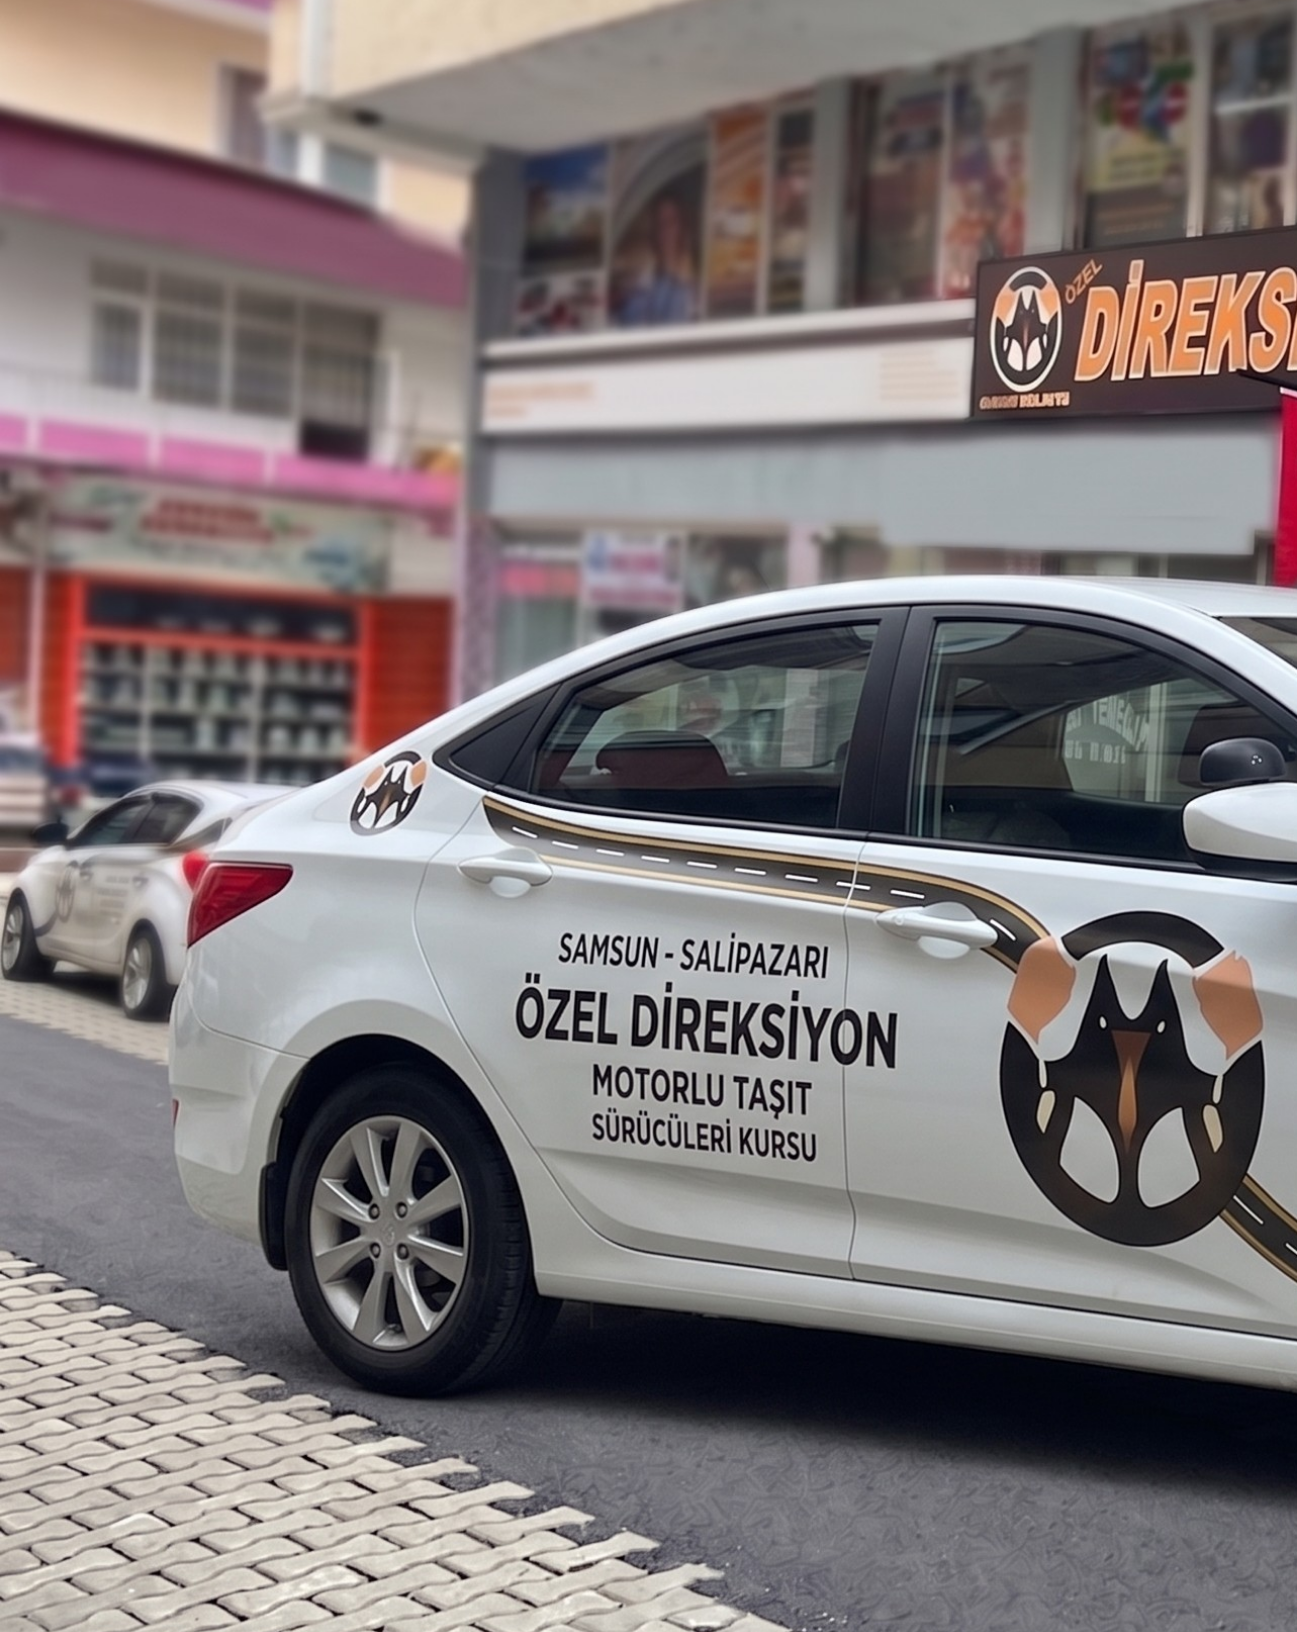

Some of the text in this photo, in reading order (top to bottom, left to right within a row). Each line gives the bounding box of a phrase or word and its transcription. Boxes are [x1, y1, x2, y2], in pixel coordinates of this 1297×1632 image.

[1065, 259, 1103, 304] ÖZEL
[558, 933, 659, 968] SAMSUN
[680, 932, 829, 979] SALİPAZARI
[516, 972, 898, 1069] ÖZEL DİREKSİYON
[593, 1064, 812, 1119] MOTORLU TAŞIT
[592, 1108, 817, 1162] SÜRÜCÜLERİ KURSU
